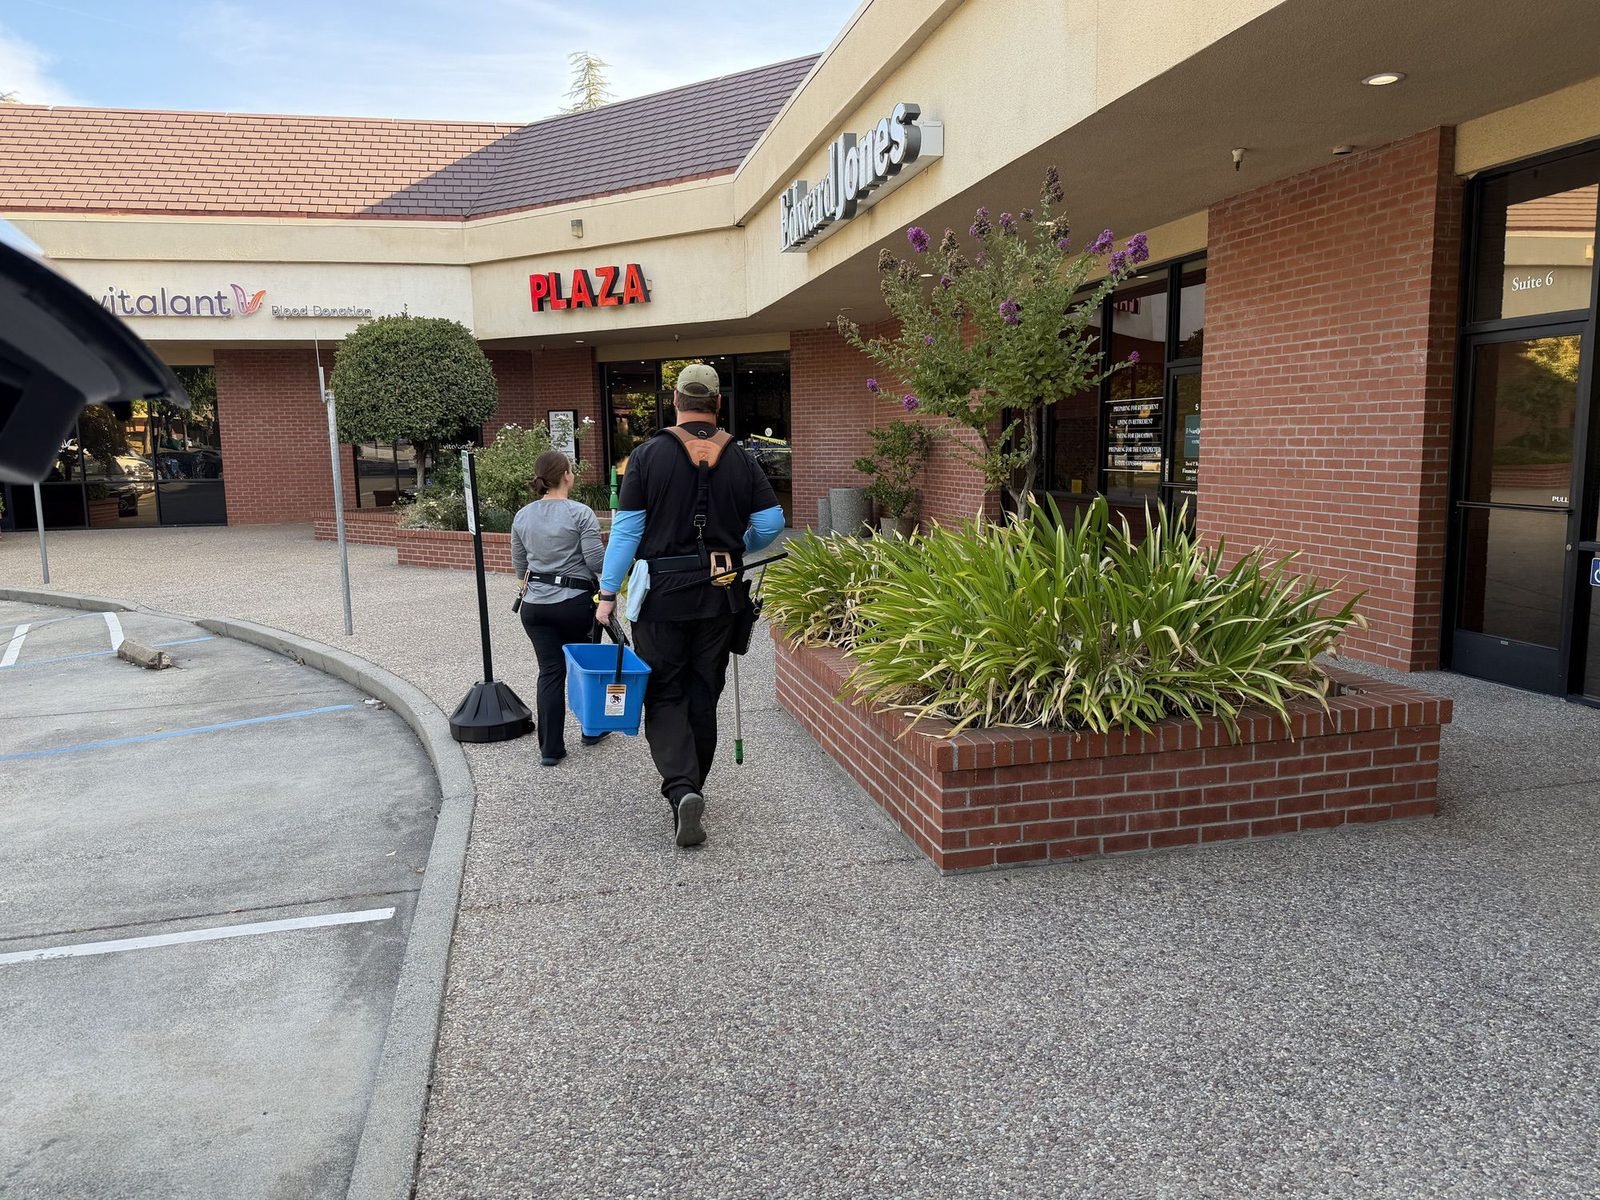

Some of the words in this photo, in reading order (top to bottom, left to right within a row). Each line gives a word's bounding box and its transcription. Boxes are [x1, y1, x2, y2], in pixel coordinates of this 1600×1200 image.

[779, 142, 839, 250] Edward
[834, 102, 920, 222] Jones
[529, 263, 651, 312] PLAZA
[1511, 276, 1542, 292] Suite
[1545, 270, 1554, 286] 6
[271, 305, 308, 316] Blood
[313, 305, 372, 316] Donation
[1551, 495, 1569, 503] PULL
